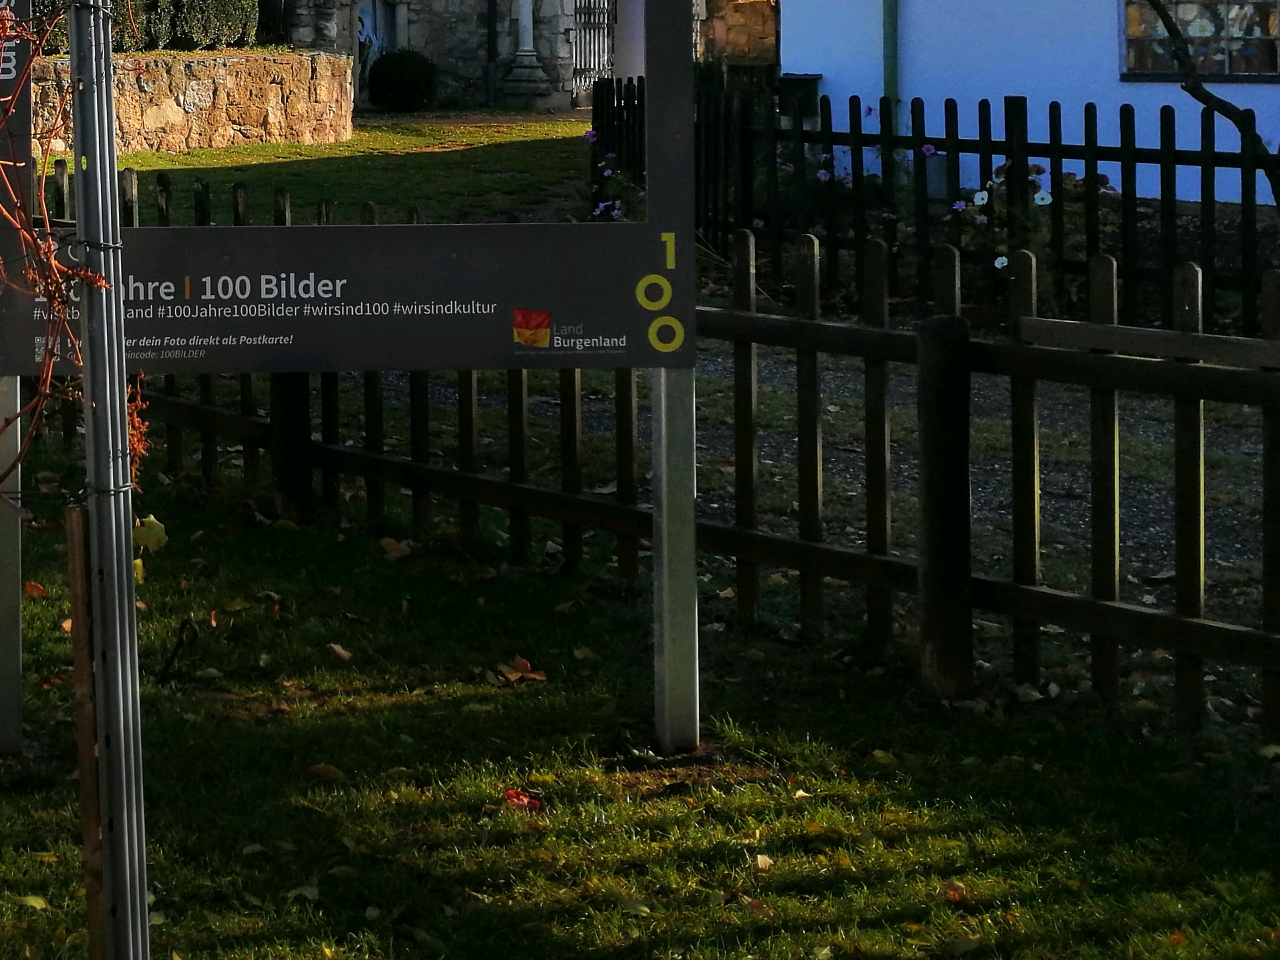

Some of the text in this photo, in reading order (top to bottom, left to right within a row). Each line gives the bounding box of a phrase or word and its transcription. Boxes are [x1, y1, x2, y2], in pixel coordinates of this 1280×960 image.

[201, 274, 252, 300] 100
[260, 272, 347, 300] Bilder
[157, 302, 300, 319] #100Jahre100Bilder
[303, 301, 389, 317] #wirsind100
[393, 299, 497, 316] #wirsindkultur
[553, 323, 583, 335] Land
[139, 336, 161, 347] dein
[163, 336, 186, 347] Foto
[188, 335, 220, 346] direkt
[221, 334, 237, 345] als
[239, 334, 294, 346] Postkarte!
[553, 335, 627, 350] Burgenland
[160, 348, 206, 359] 100BILDER
